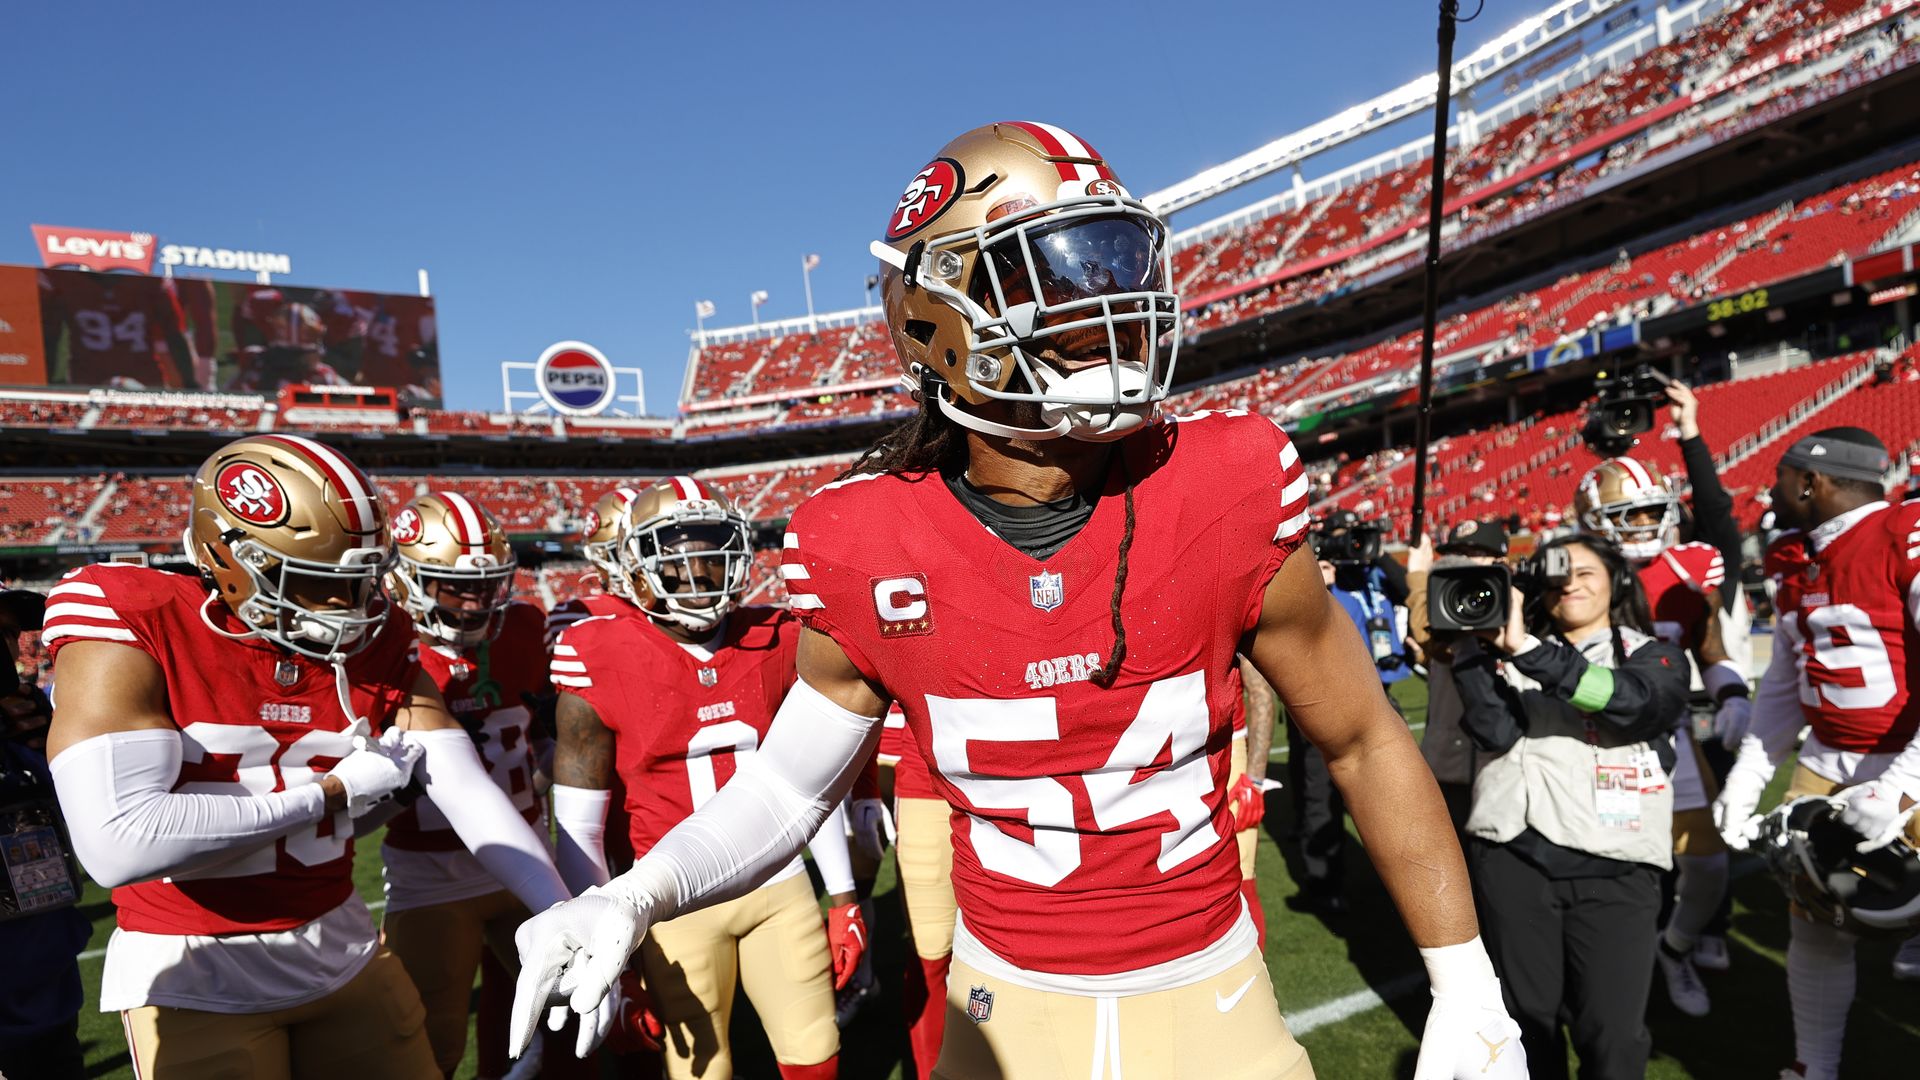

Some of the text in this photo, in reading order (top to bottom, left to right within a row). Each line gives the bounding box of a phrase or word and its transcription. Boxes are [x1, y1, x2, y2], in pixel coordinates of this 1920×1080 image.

[159, 244, 291, 275] STADIUM
[75, 310, 149, 353] 94
[547, 371, 605, 386] PEPSI
[874, 577, 927, 621] C
[1035, 588, 1060, 605] NFL
[1024, 652, 1102, 689] 49ERS
[259, 703, 313, 724] 49ERS
[924, 669, 1221, 888] 54
